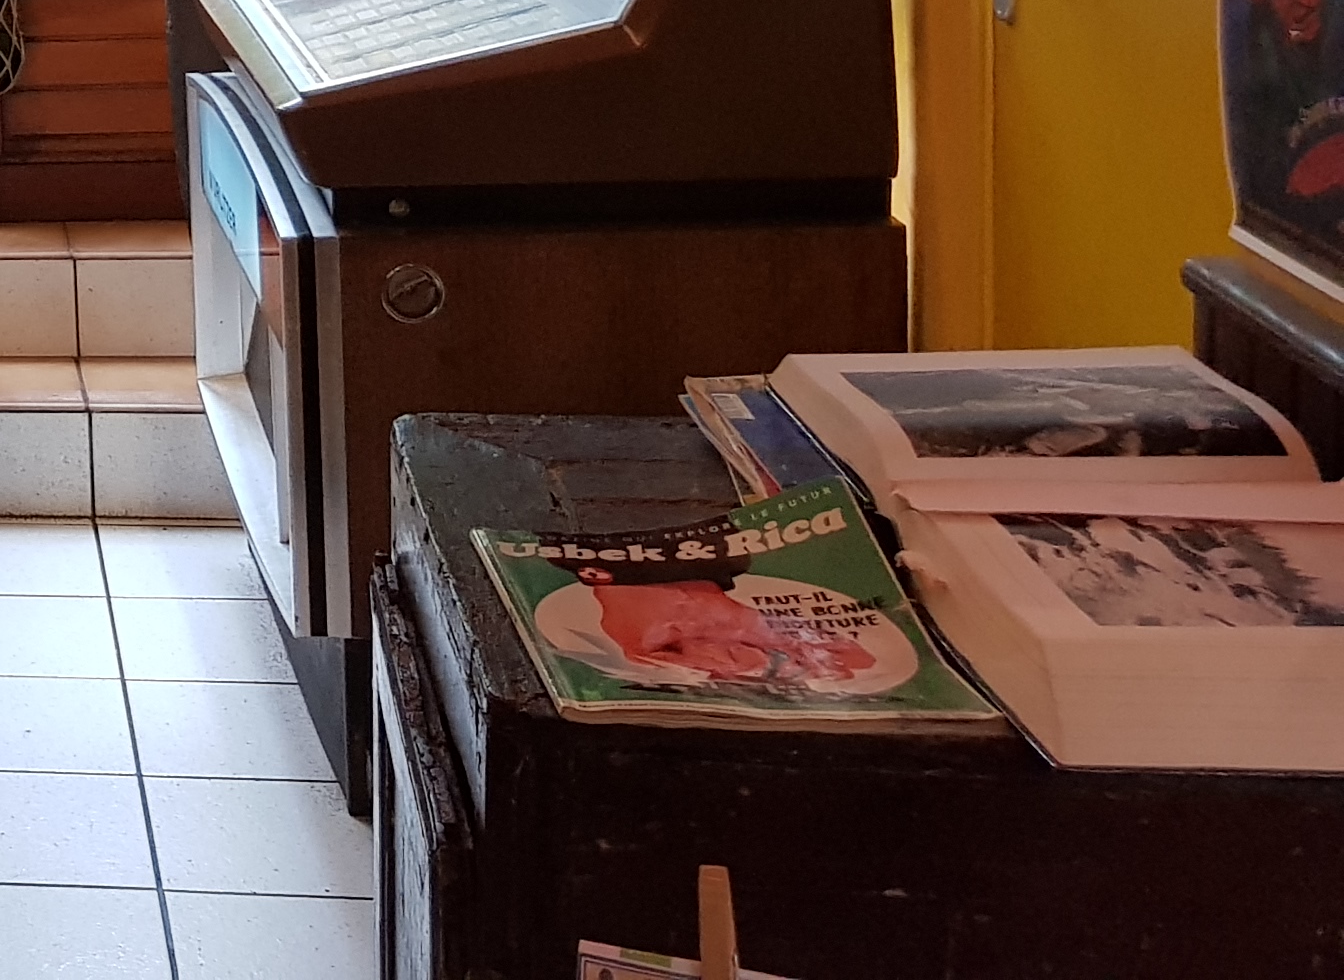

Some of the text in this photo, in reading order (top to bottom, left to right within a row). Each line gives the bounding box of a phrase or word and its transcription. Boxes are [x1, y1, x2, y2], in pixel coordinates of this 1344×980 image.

[777, 486, 832, 512] FUTUR
[496, 506, 848, 562] Usbek & Rica
[751, 591, 833, 607] FAUT-IL
